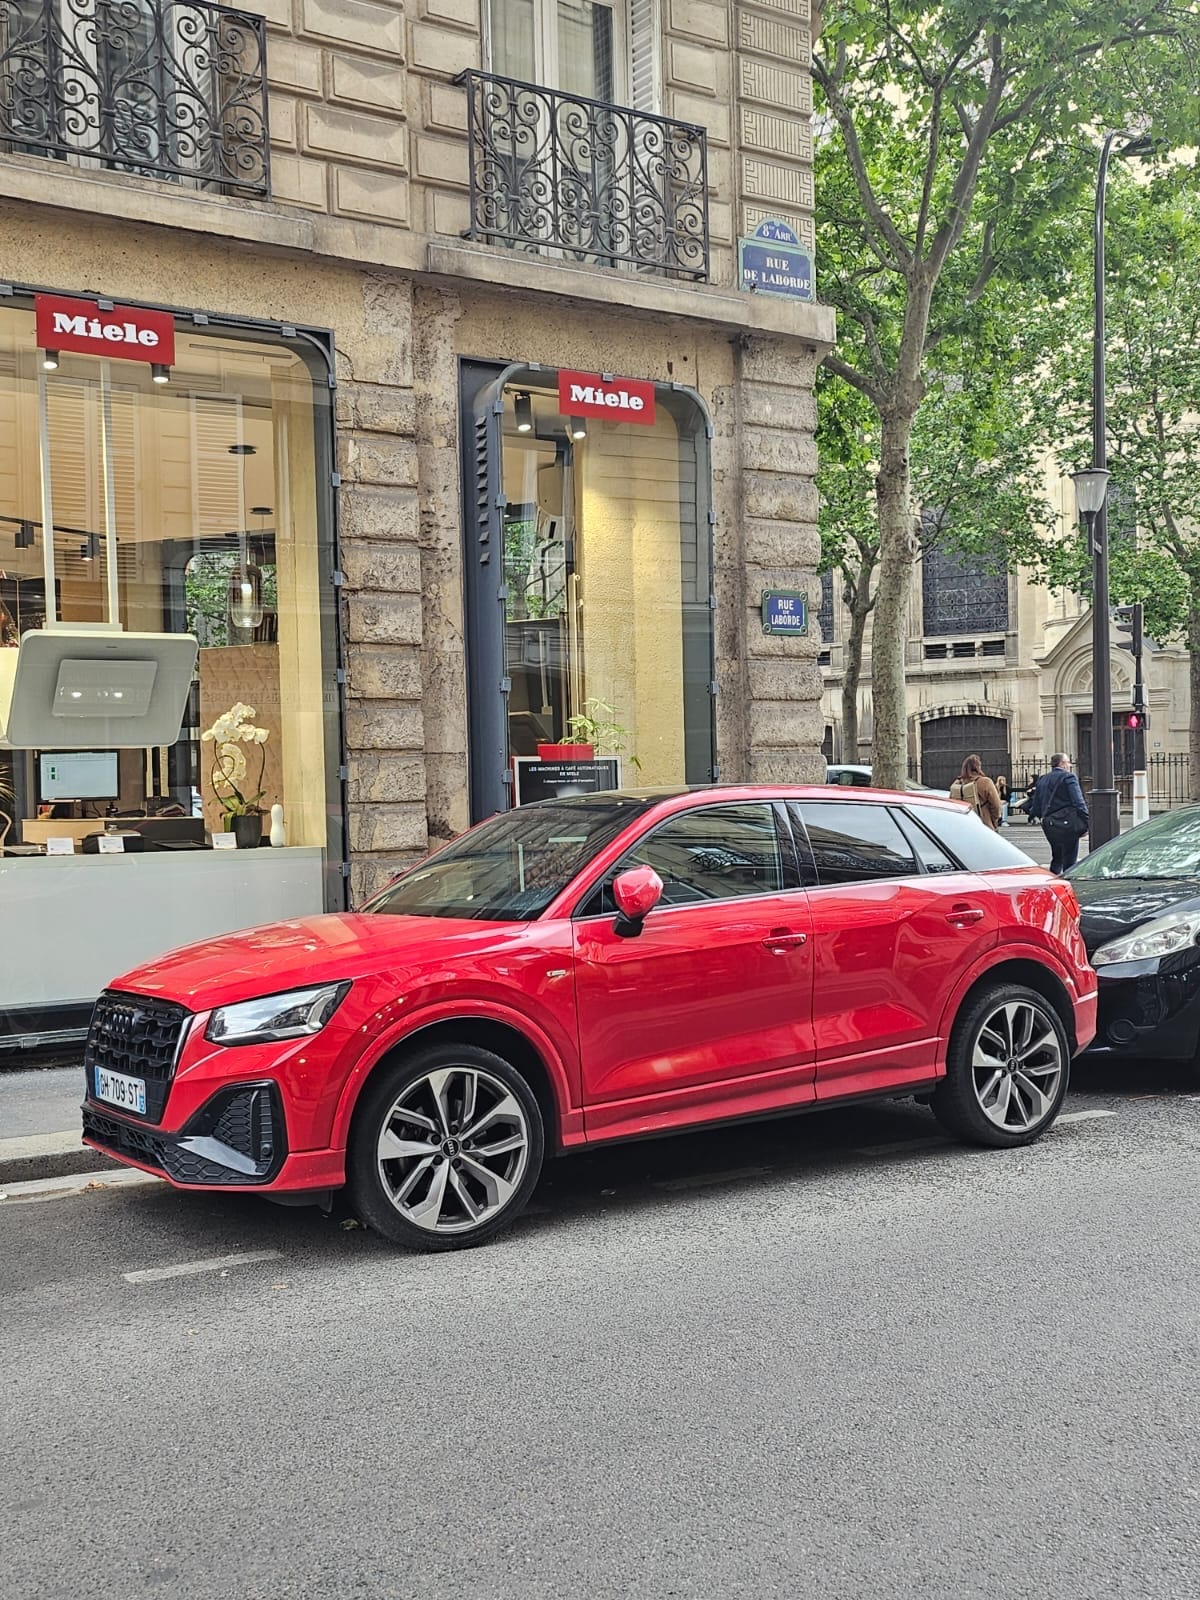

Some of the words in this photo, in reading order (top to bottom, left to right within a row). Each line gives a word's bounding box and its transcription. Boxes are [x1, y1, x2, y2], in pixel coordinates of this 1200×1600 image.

[767, 257, 790, 271] RUE
[743, 268, 759, 281] DE
[762, 271, 811, 290] LABORDE
[53, 312, 159, 347] Miele
[570, 384, 644, 410] Miele
[777, 599, 794, 610] RUE
[771, 614, 801, 625] LABORDE
